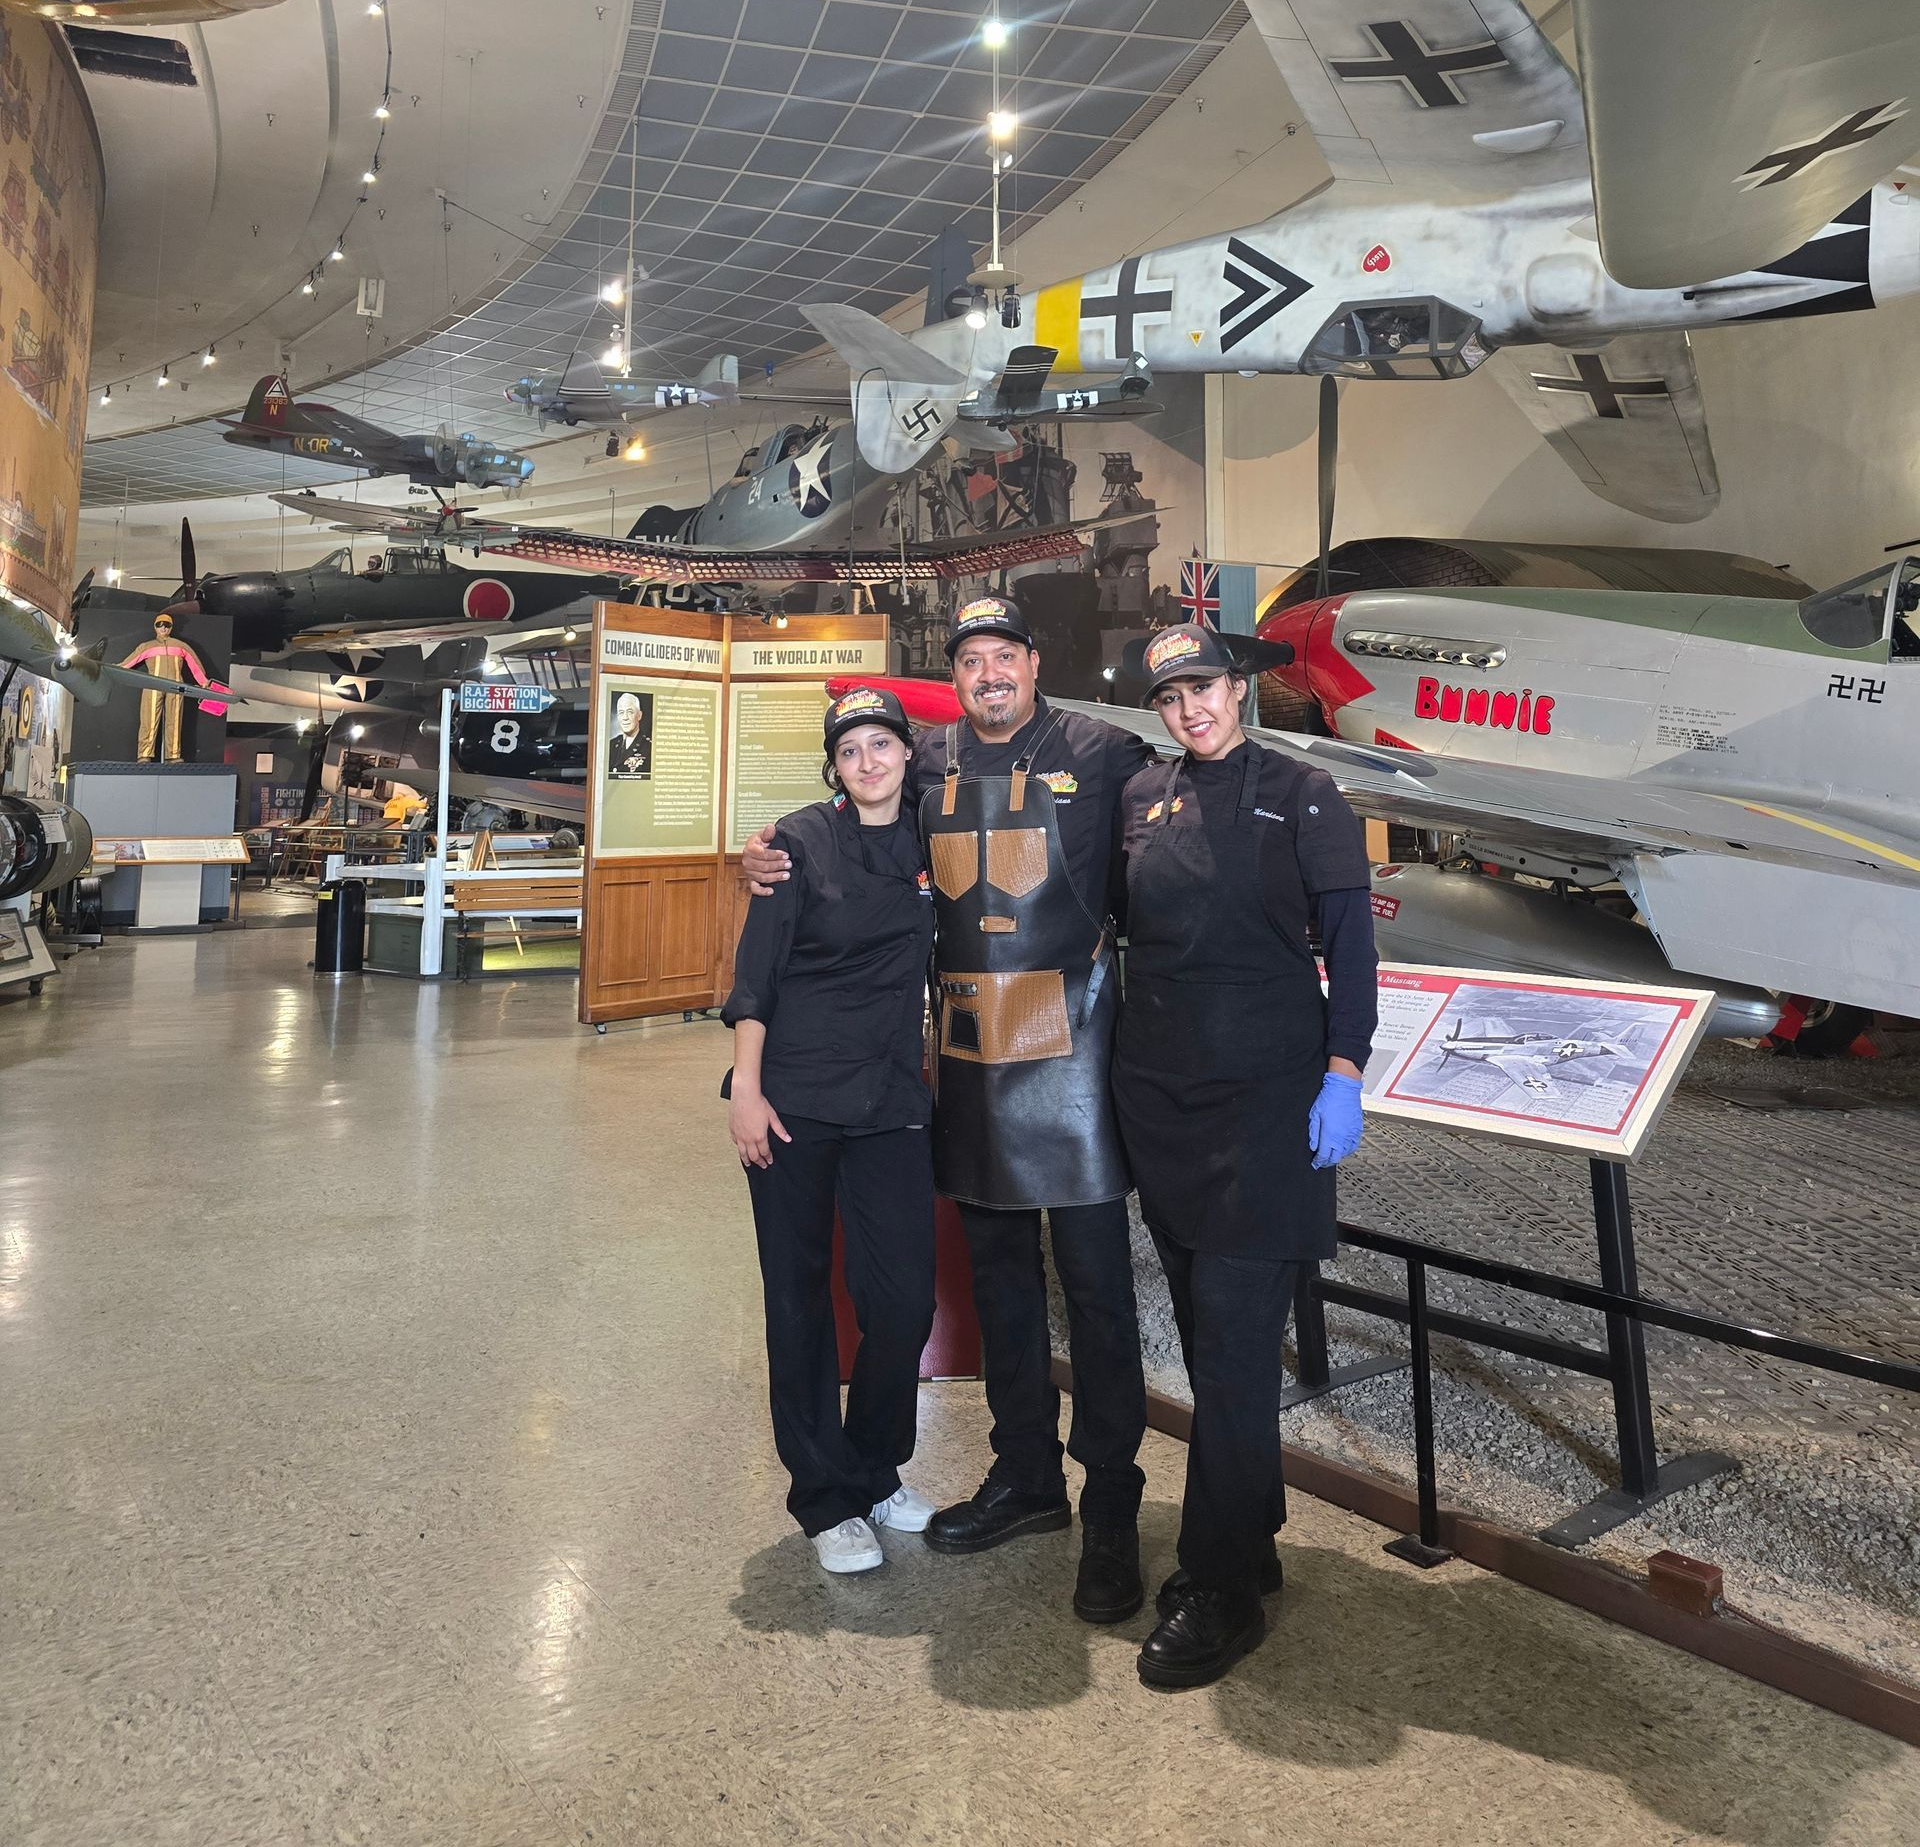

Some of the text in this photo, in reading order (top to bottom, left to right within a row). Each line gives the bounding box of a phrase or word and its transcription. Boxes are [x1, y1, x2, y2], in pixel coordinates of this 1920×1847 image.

[748, 477, 765, 504] 24
[605, 639, 720, 665] COMBAT GLIDERS OF WWII
[753, 649, 863, 665] THE WORLD AT WAR
[465, 687, 538, 698] R.A.F. STATION
[465, 698, 537, 709] BIGGIN HILL
[490, 719, 520, 753] 8
[276, 788, 306, 798] FIGHTIN
[1384, 975, 1423, 988] Mustang
